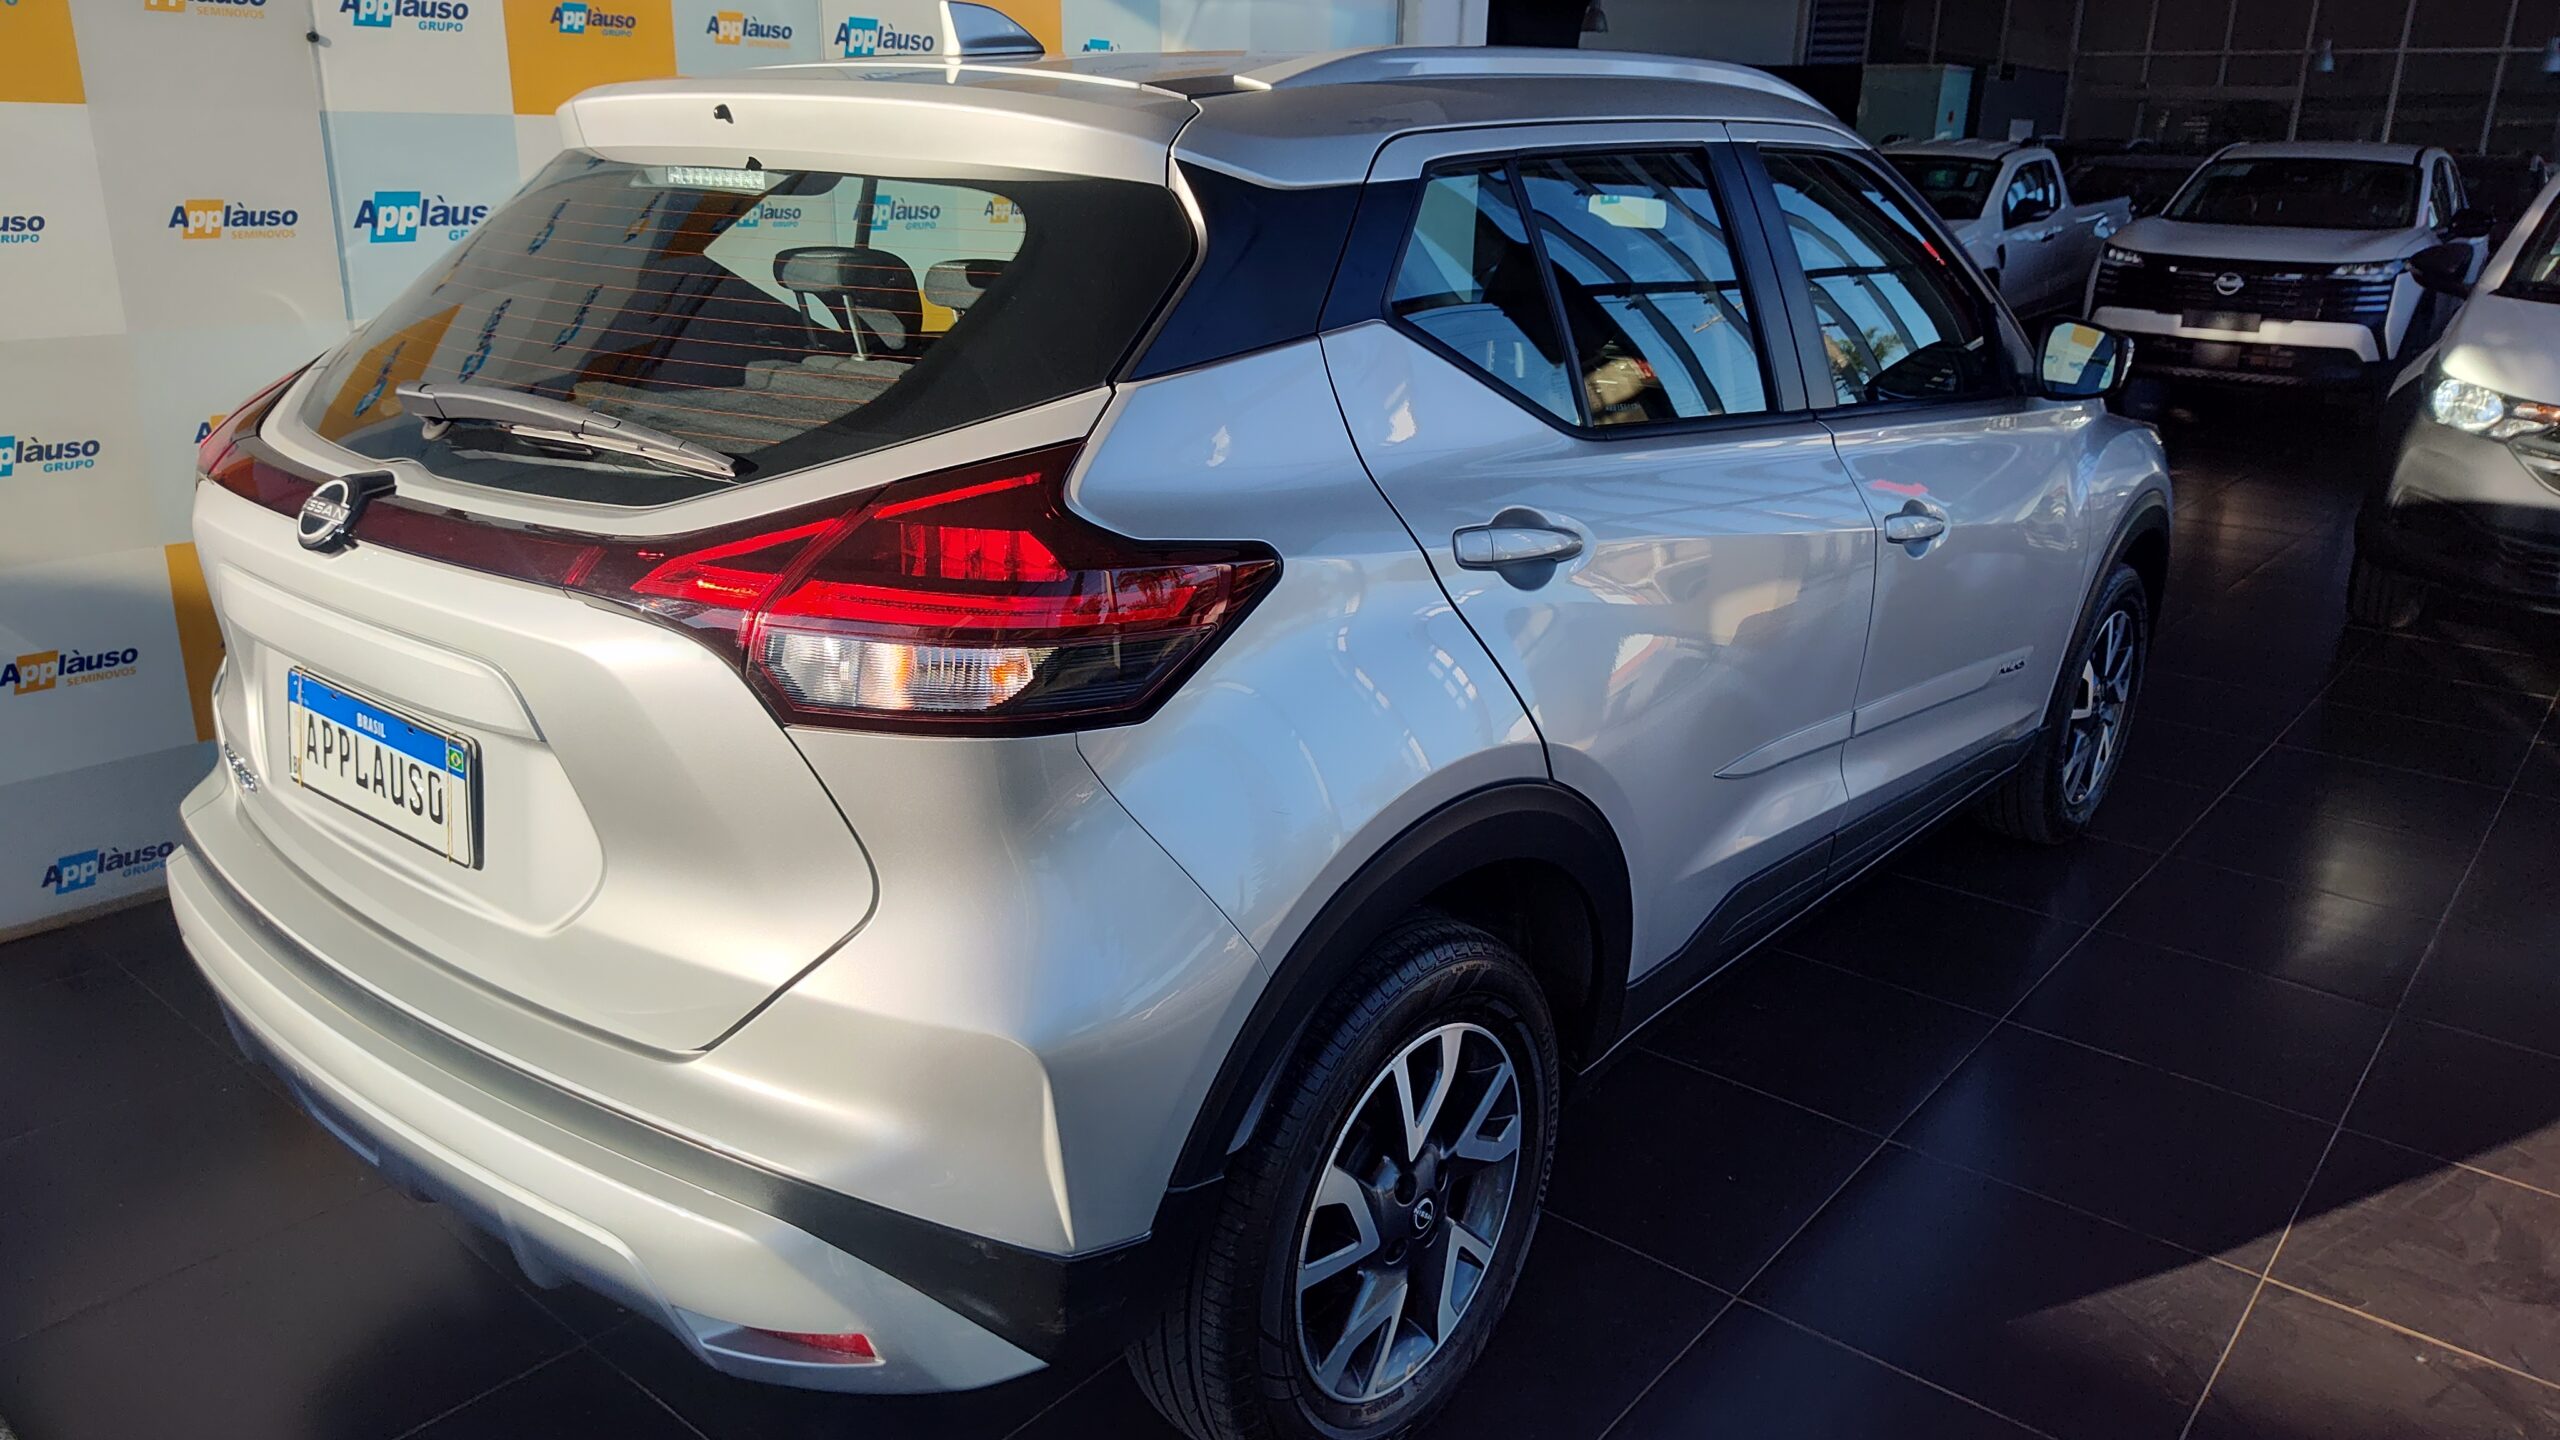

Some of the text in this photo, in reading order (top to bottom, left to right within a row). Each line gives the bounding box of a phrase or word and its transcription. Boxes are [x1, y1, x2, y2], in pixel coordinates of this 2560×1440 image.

[418, 20, 463, 32] GRUPO
[550, 6, 636, 30] Applàuso
[706, 16, 792, 41] Applàuso
[834, 23, 934, 55] Applàuso
[168, 202, 298, 234] Applàuso
[353, 195, 489, 236] Applàus
[0, 234, 40, 243] RUPO
[231, 229, 297, 240] SEMINOVOS
[0, 437, 100, 473] plàuso
[43, 459, 94, 473] GRUPO
[0, 648, 138, 689] Applàuso
[66, 666, 137, 687] SEMINOVOS
[357, 712, 386, 738] BRASIL
[306, 714, 443, 825] APPLAUSO
[41, 841, 175, 888] Applàuso
